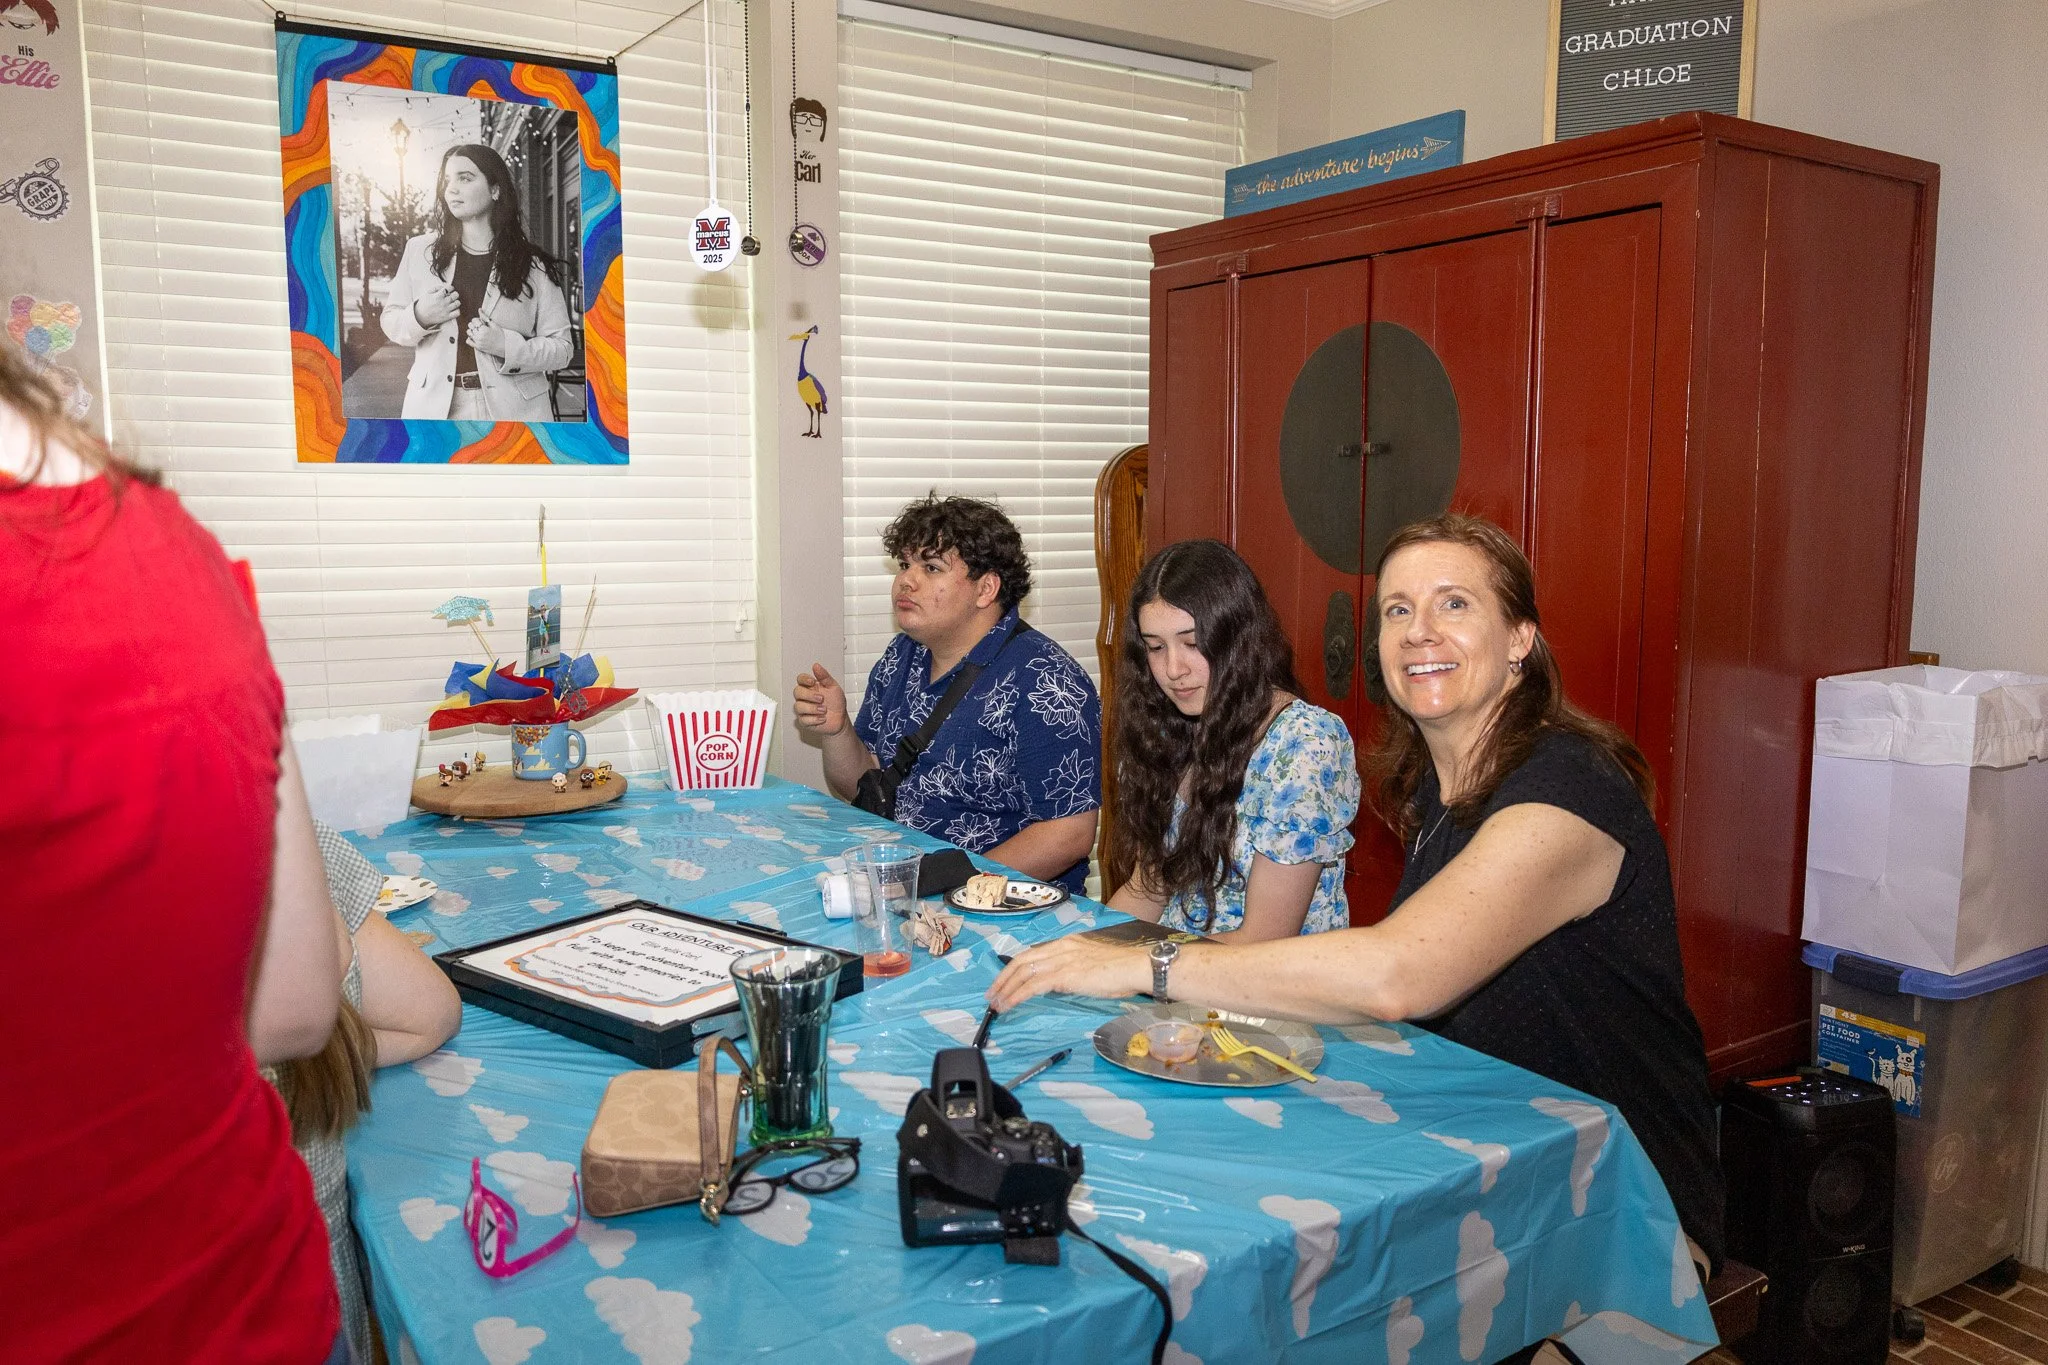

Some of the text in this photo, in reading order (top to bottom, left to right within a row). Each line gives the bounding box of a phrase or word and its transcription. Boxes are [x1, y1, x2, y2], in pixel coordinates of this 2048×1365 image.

[1565, 16, 1732, 53] GRADUATION
[18, 45, 34, 57] His
[0, 55, 60, 89] Ellie
[1603, 64, 1691, 91] CHLOE
[795, 161, 821, 183] Carl
[1255, 143, 1419, 195] the adventure begins
[27, 184, 56, 207] GRAPE
[40, 197, 57, 210] SODA
[696, 230, 729, 239] marcus
[703, 254, 723, 264] 2025
[700, 752, 734, 761] CORN
[706, 743, 729, 752] POP
[631, 922, 659, 933] OUR
[660, 931, 735, 953] ADVENTURE
[646, 955, 699, 972] adventure
[699, 969, 728, 980] book
[1821, 1029, 1860, 1045] CONTAINER
[1822, 1022, 1835, 1032] PET
[1838, 1028, 1860, 1040] FOOD
